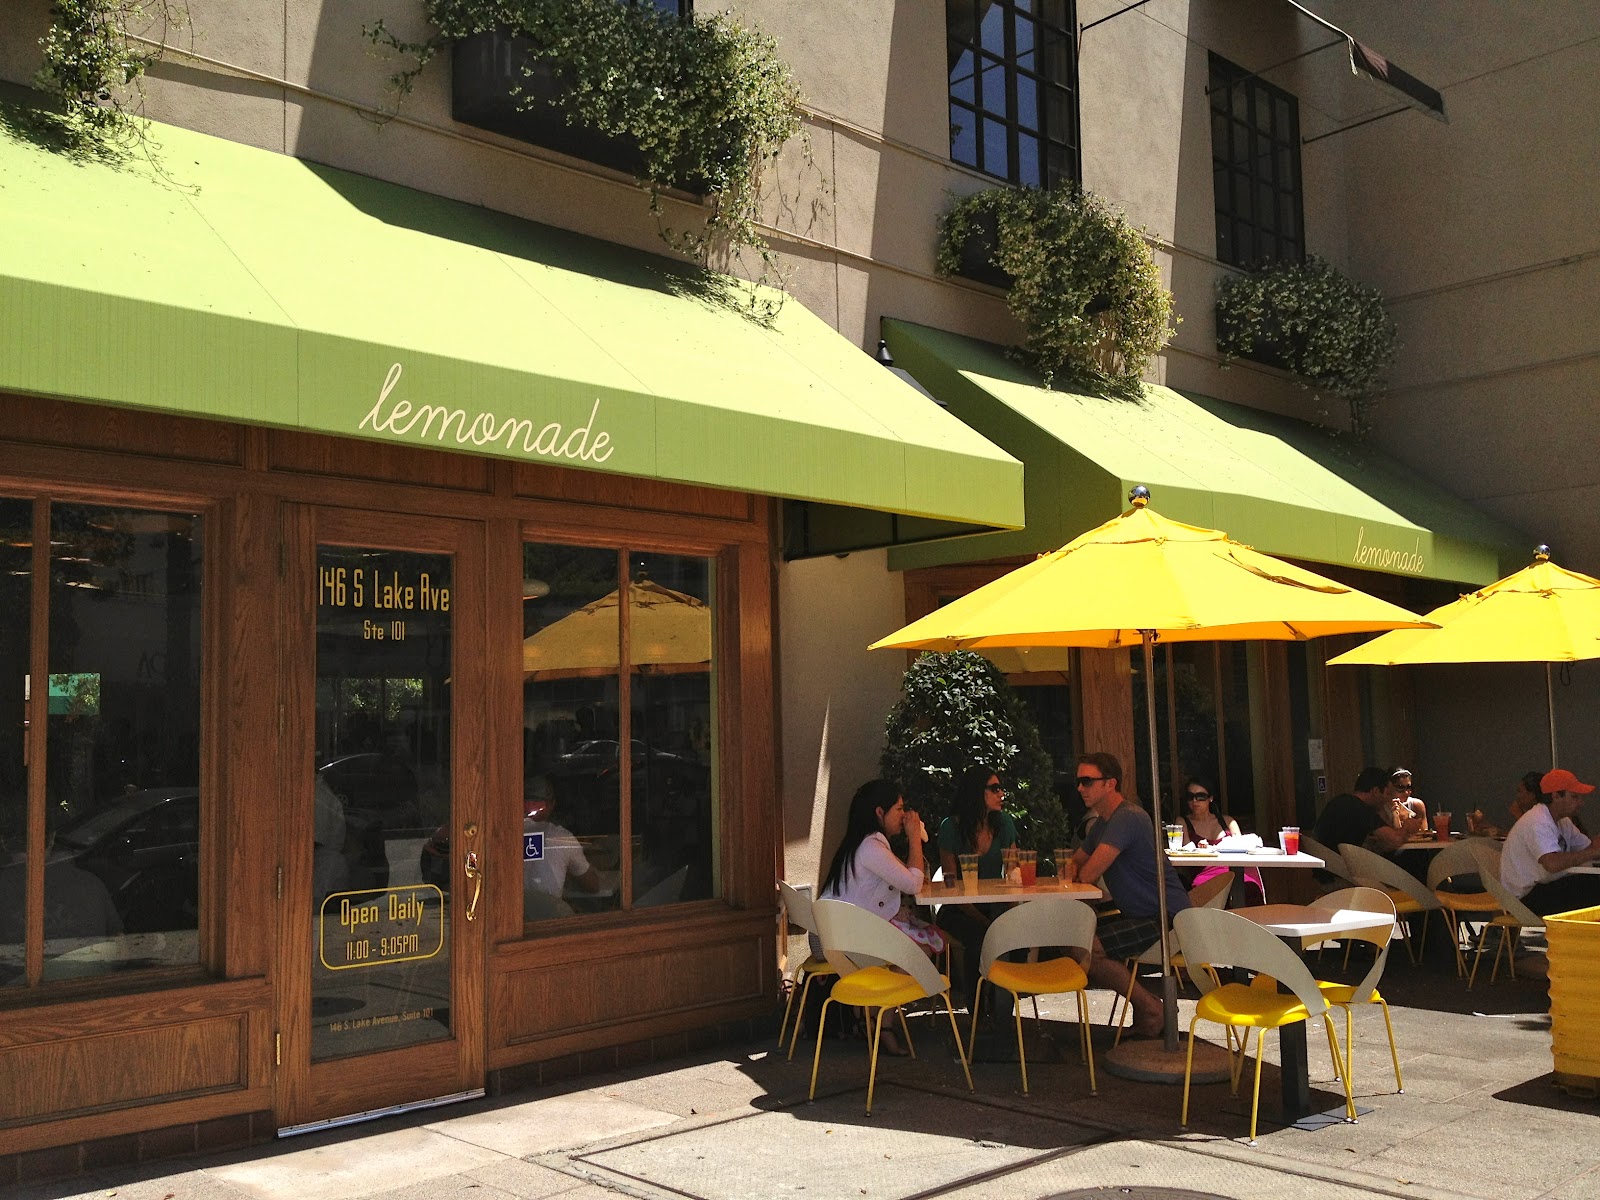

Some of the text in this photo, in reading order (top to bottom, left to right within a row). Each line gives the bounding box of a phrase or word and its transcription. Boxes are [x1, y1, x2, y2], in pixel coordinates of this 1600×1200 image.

[358, 362, 614, 463] lemonade
[1352, 526, 1425, 573] lemonade
[319, 566, 450, 612] 146 S Lake Ave
[363, 619, 405, 641] Ste 101
[340, 892, 424, 934] Open Daily
[346, 939, 369, 961] 11:00
[352, 1018, 371, 1029] Lake
[402, 1010, 421, 1021] Suite
